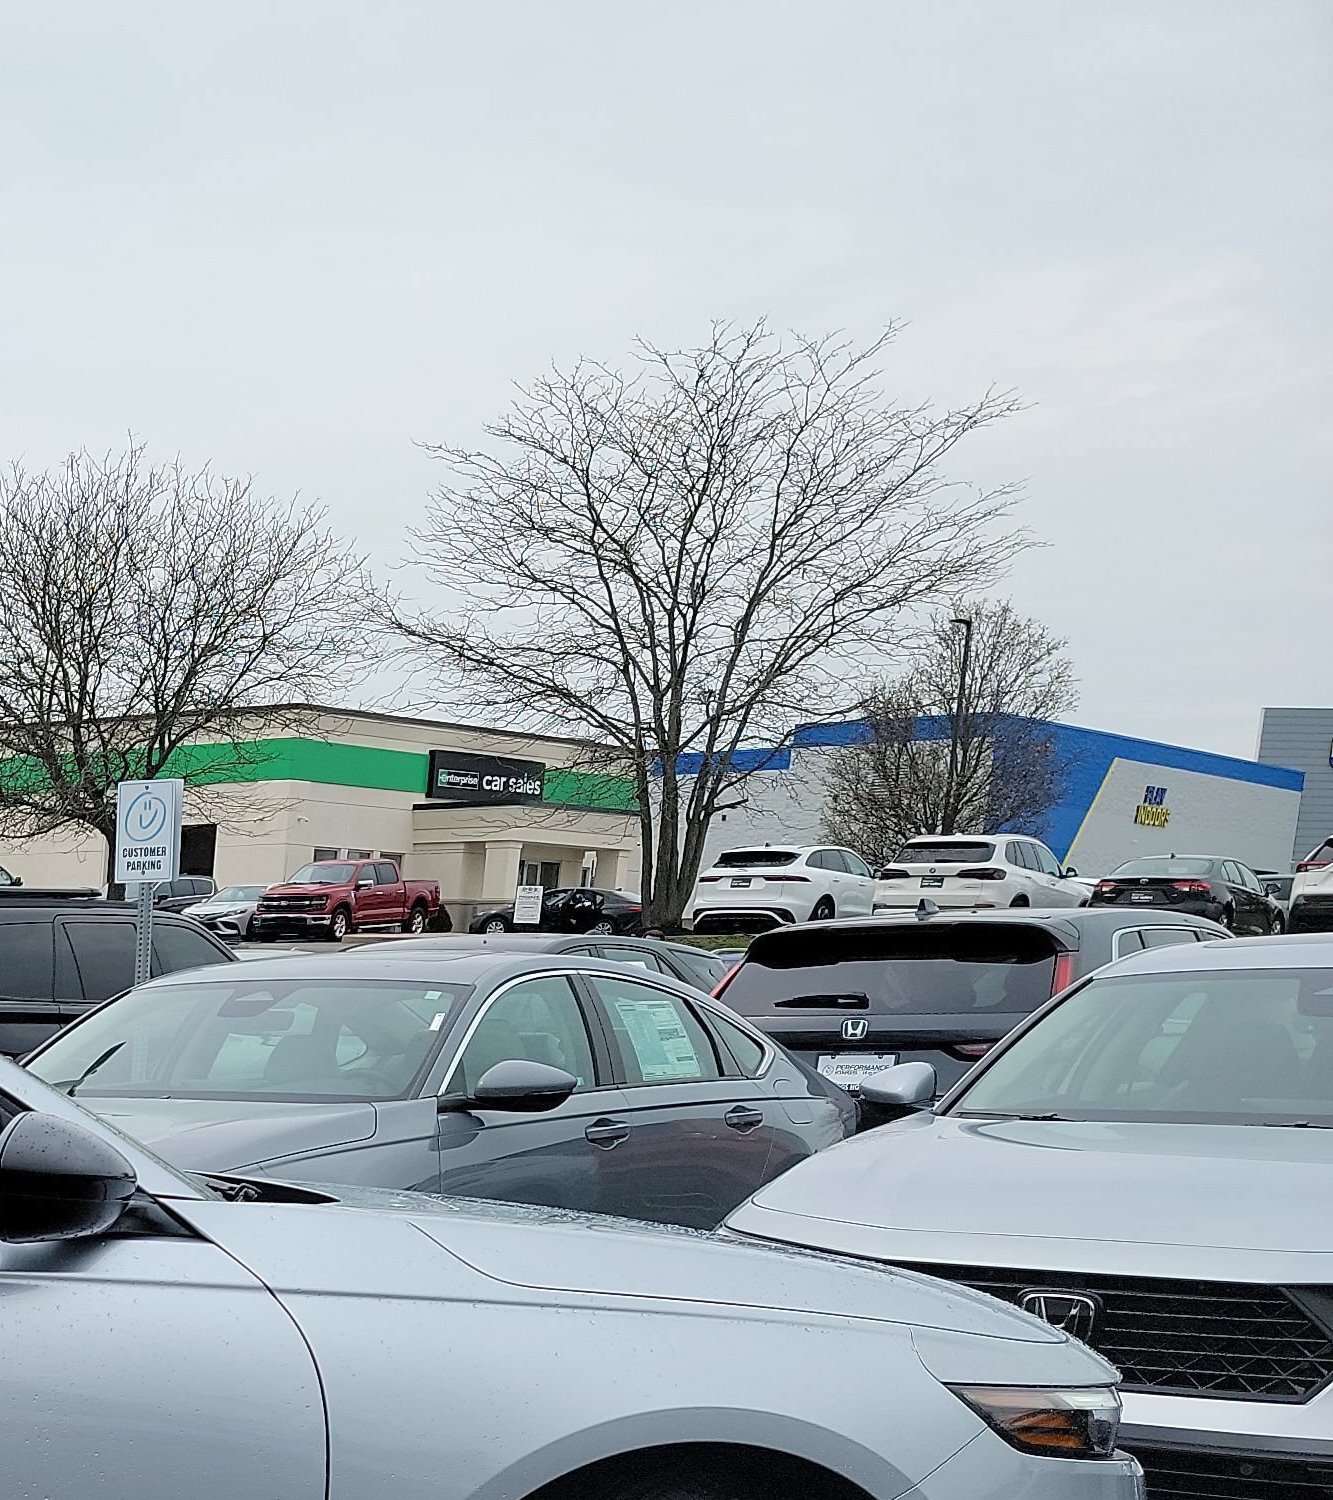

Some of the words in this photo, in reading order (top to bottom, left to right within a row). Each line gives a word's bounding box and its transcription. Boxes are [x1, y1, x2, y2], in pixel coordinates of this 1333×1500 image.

[439, 772, 478, 786] enterprise
[482, 775, 506, 791] car
[508, 772, 541, 795] sales
[1134, 805, 1170, 828] INDOORS
[122, 846, 167, 858] CUSTOMER
[126, 860, 162, 871] PARKING
